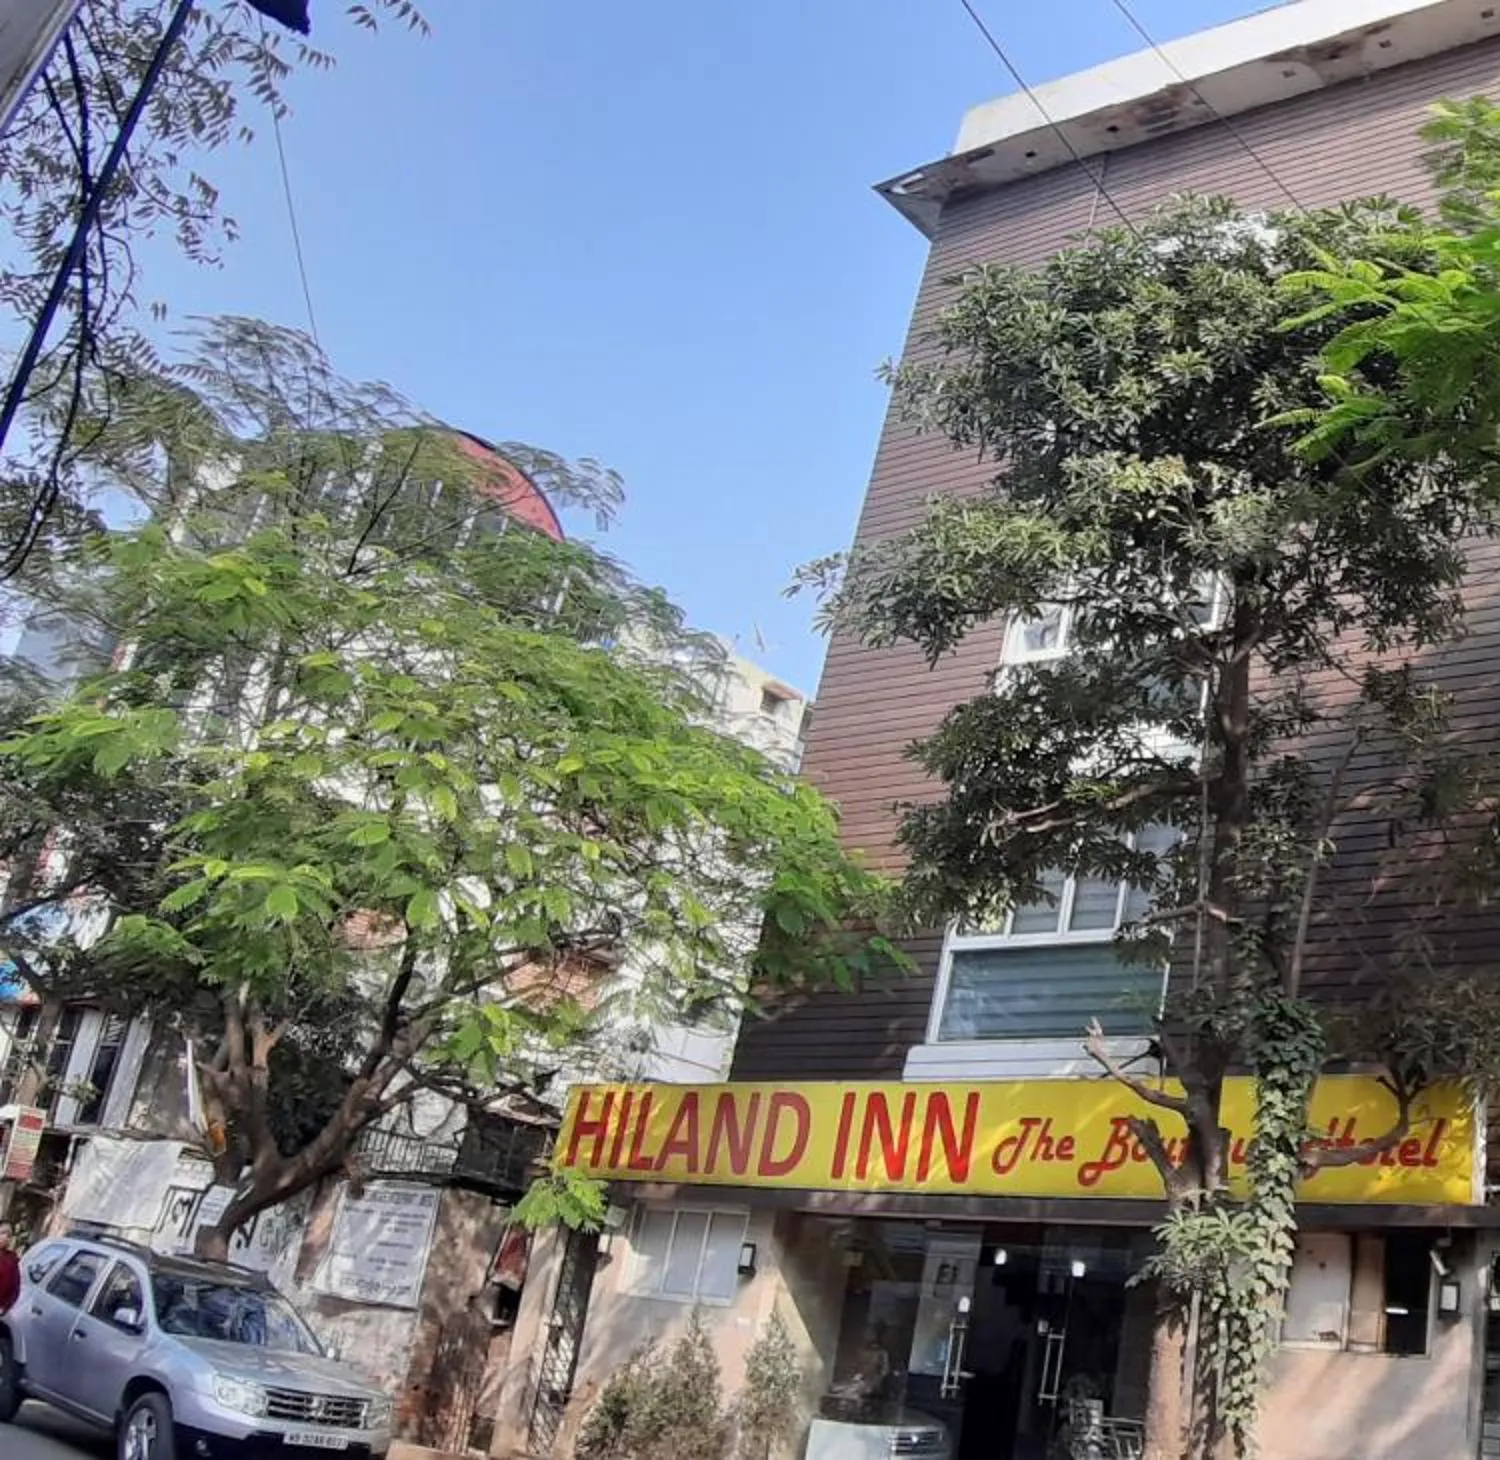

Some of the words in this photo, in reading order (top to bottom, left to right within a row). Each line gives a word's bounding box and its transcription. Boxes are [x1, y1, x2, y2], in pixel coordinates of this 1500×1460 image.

[564, 1091, 812, 1177] HILAND
[830, 1091, 981, 1184] INN
[991, 1116, 1076, 1175] The
